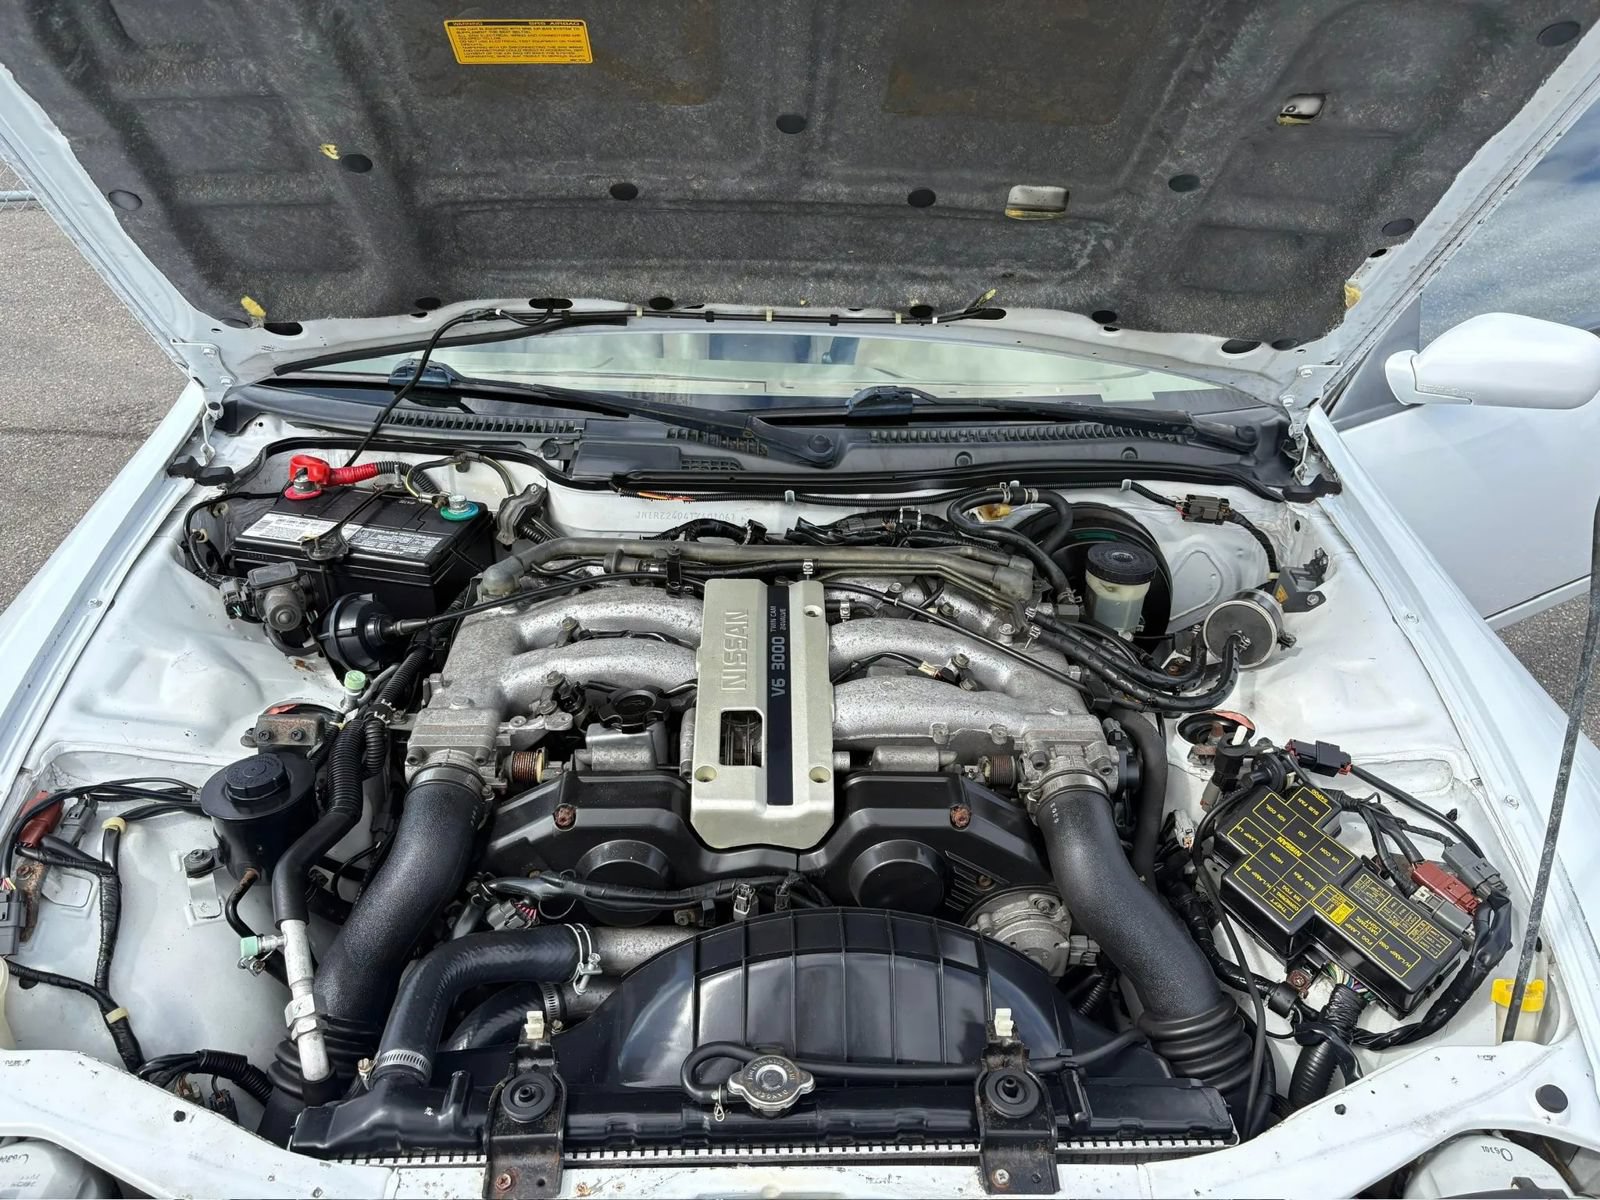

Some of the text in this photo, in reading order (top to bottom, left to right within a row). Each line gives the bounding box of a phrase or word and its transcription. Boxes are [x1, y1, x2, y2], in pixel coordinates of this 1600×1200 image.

[722, 610, 748, 691] NISSAN
[771, 636, 785, 697] V6 3000
[1297, 796, 1308, 807] FAN
[1276, 834, 1302, 857] NISSAN
[1268, 851, 1284, 865] HORN
[1251, 871, 1272, 888] H/LAMP
[1281, 884, 1293, 895] FOG
[1270, 897, 1287, 913] THEFT
[1355, 915, 1379, 936] DAYTIME
[1365, 918, 1382, 933] LIGHT
[1344, 923, 1373, 946] FOG LAMP
[1389, 950, 1411, 968] H/LAMP
